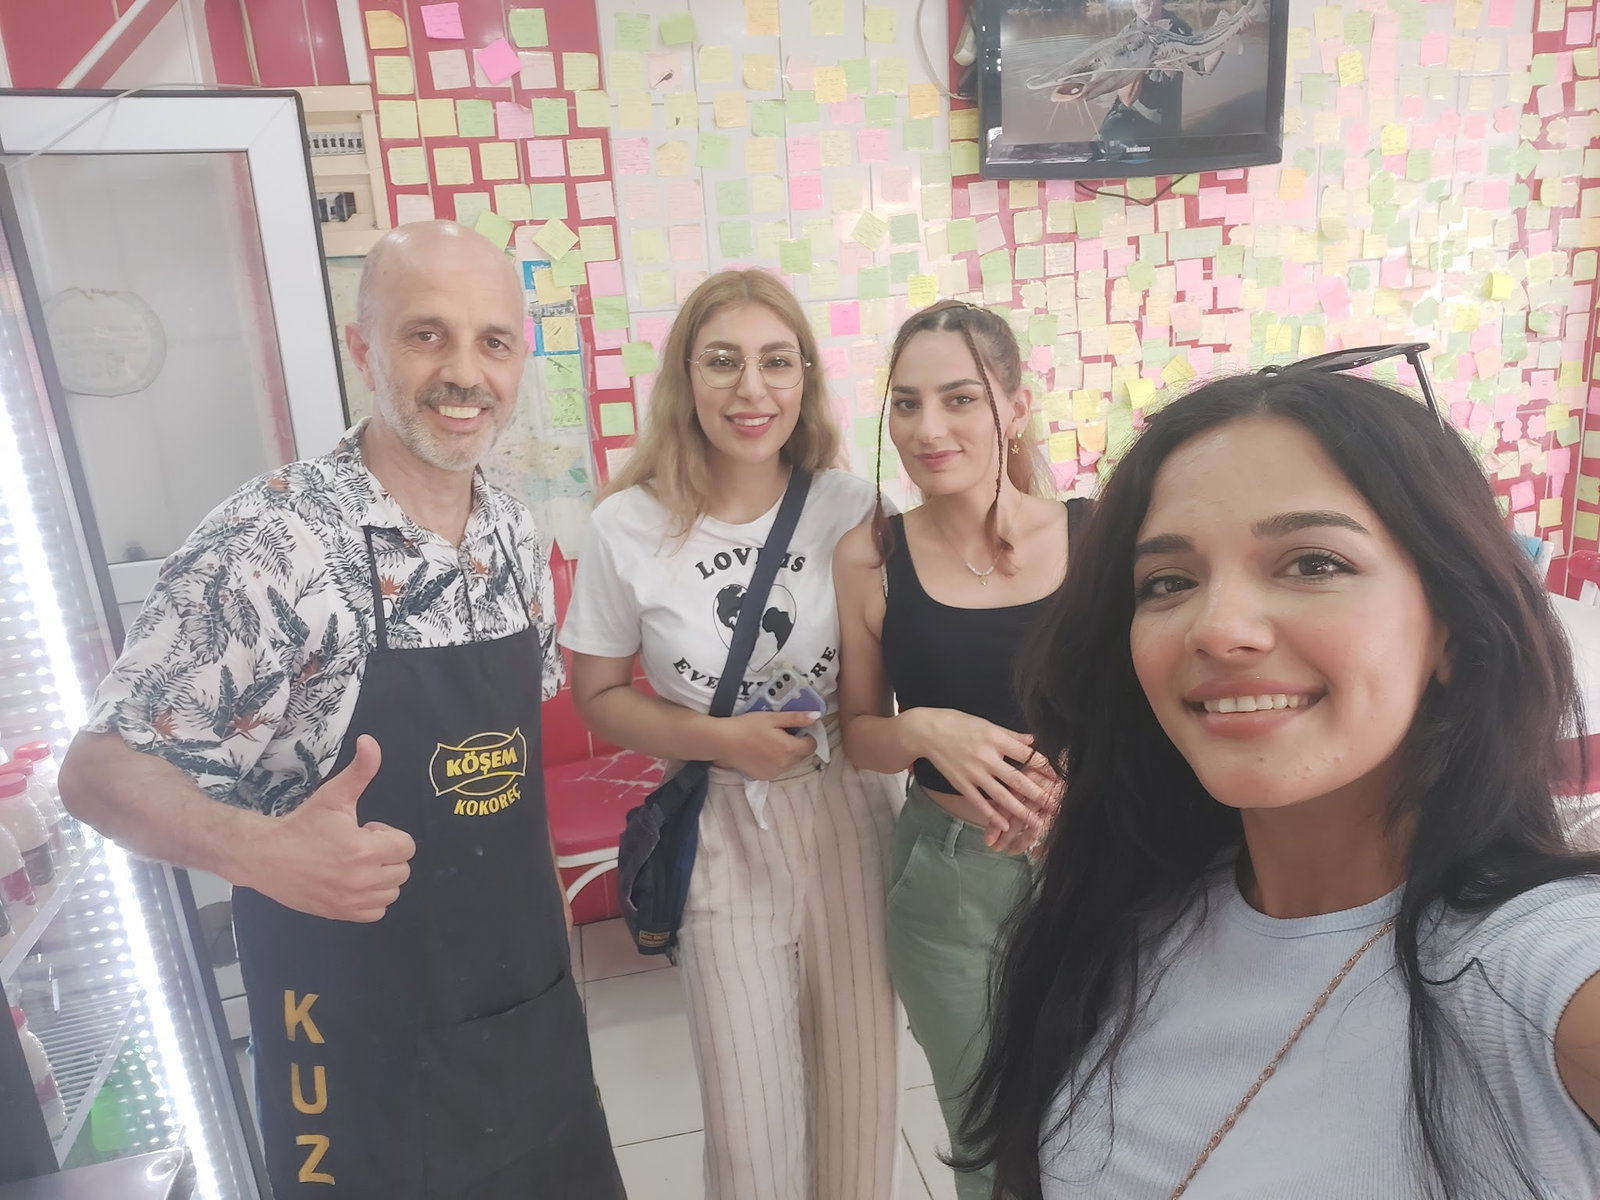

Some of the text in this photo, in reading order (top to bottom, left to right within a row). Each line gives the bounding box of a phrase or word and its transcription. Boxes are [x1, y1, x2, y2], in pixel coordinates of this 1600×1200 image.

[695, 547, 765, 580] LOV
[446, 747, 518, 777] KÖŞEM
[453, 782, 521, 816] KOKOREÇ
